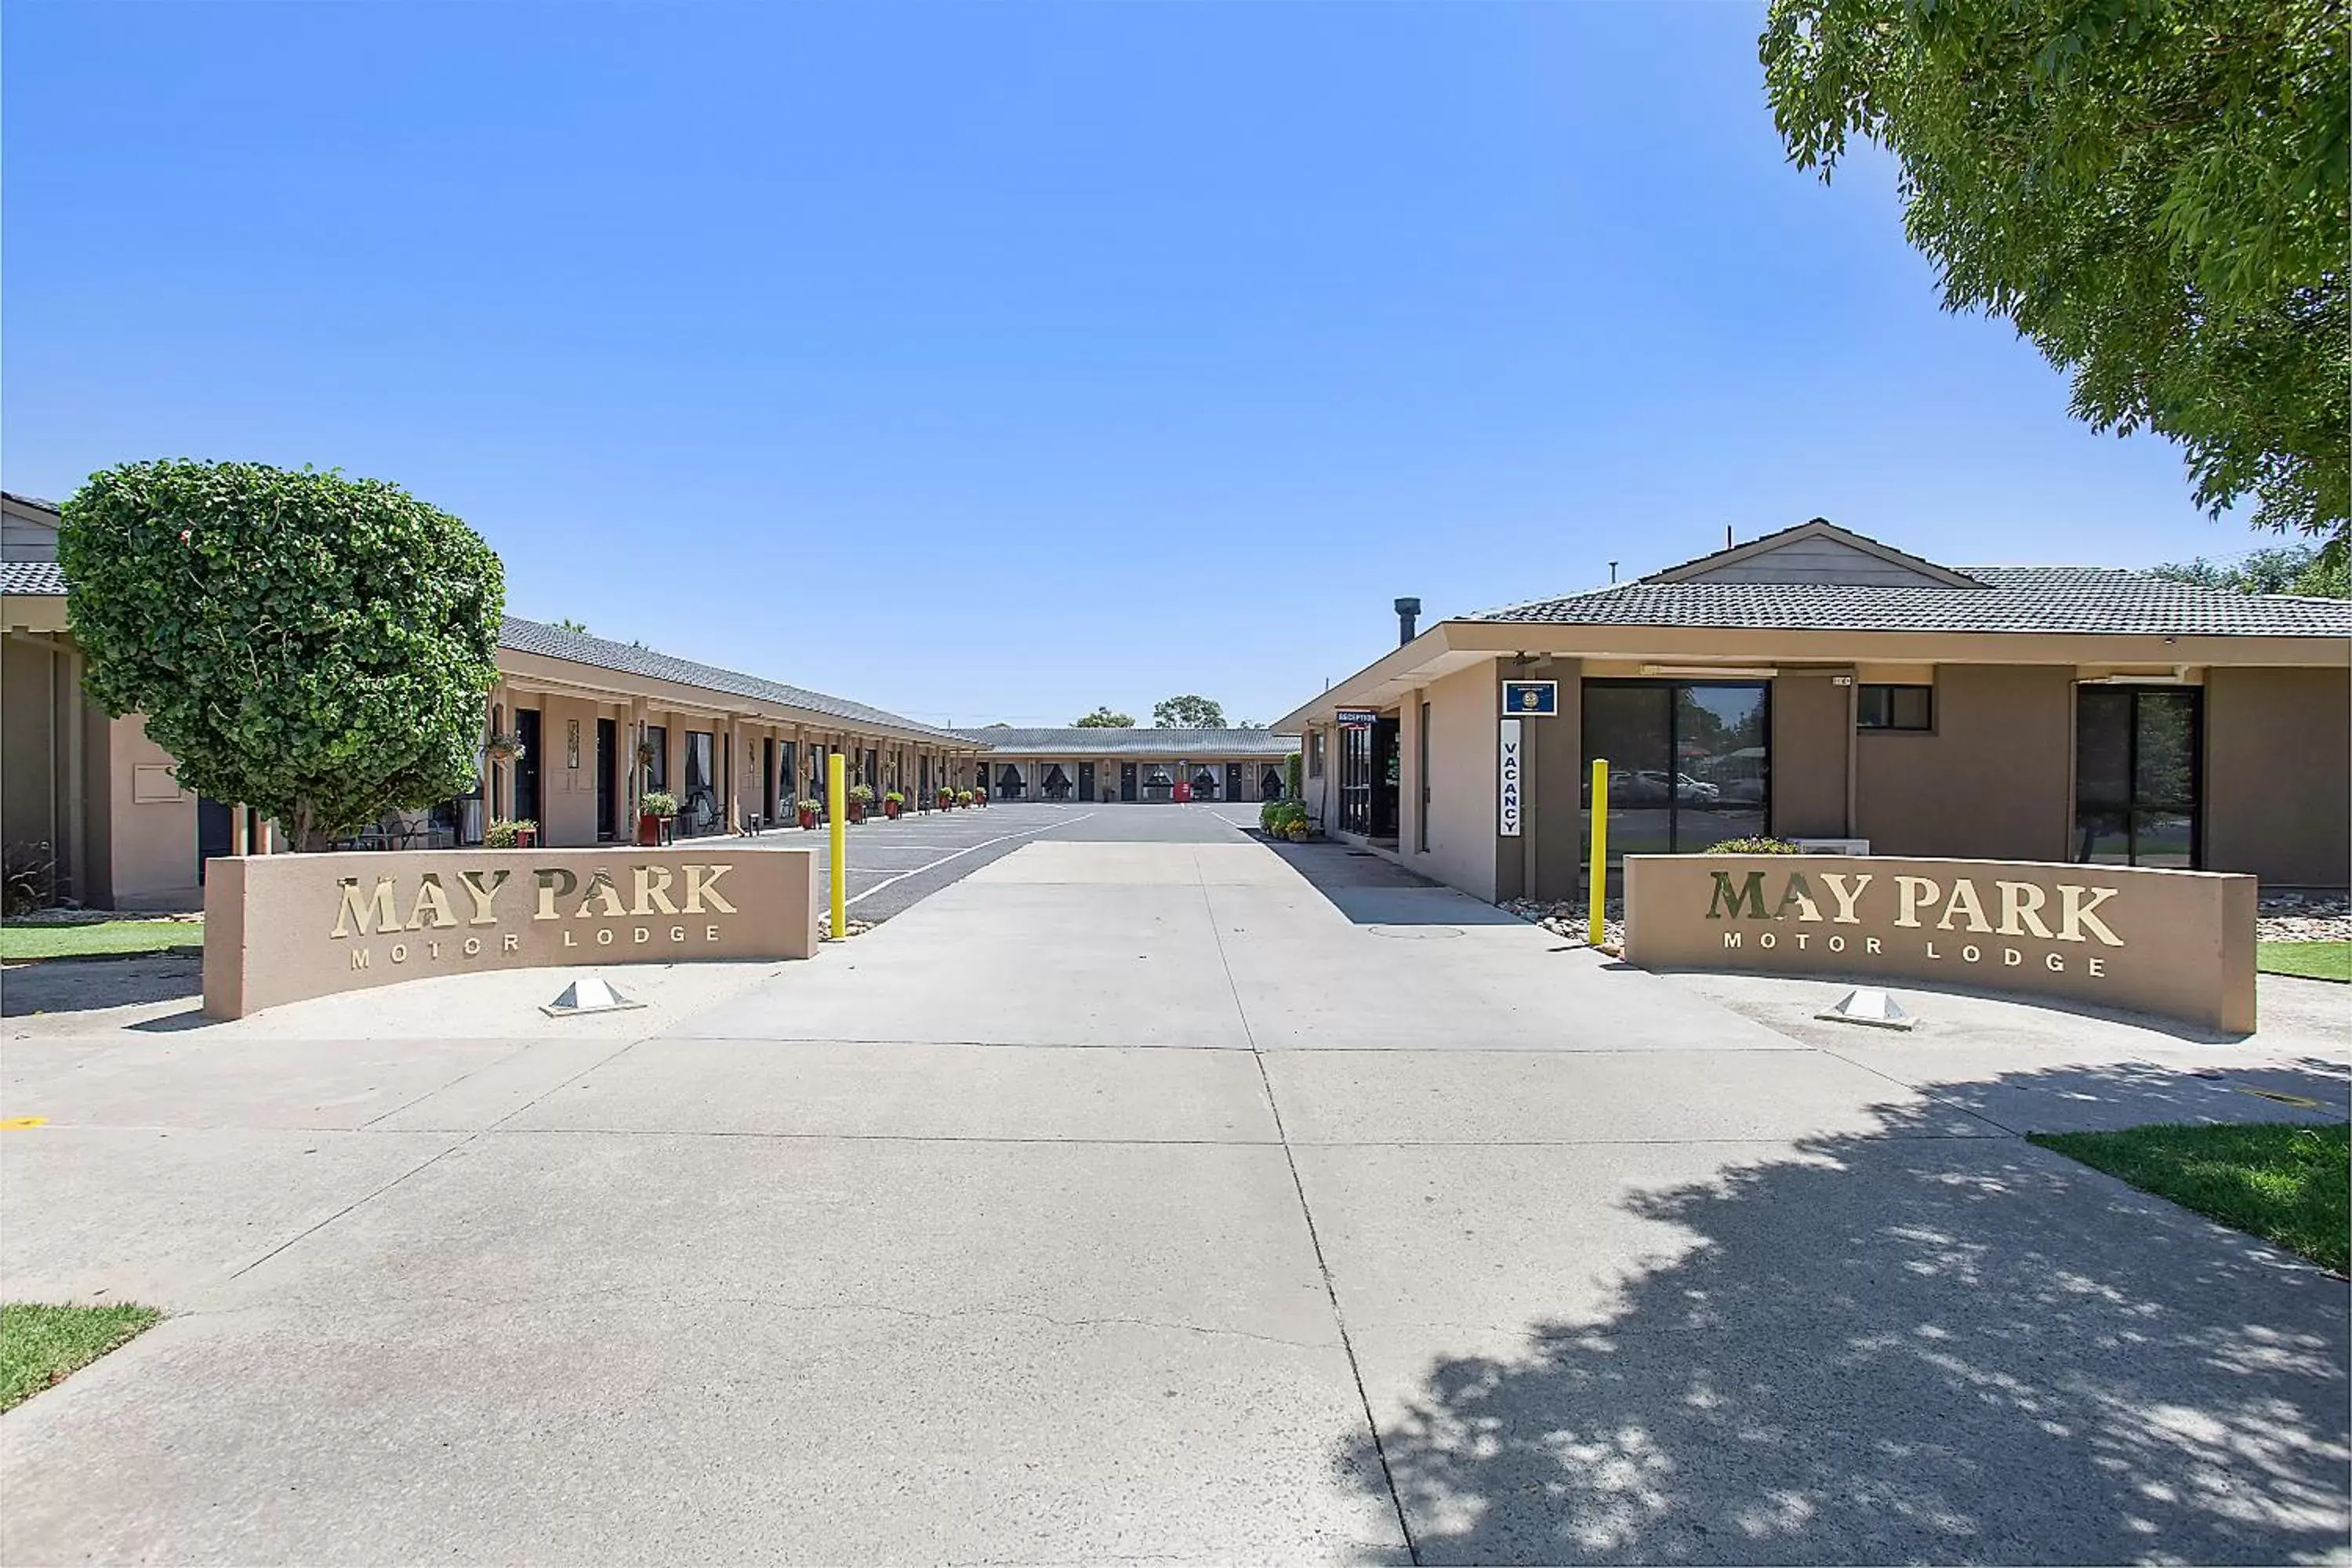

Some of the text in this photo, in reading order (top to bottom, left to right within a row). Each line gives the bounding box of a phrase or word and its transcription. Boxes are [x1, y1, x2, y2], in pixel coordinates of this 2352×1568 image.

[1338, 713, 1376, 721] RECEPTION
[1504, 743, 1517, 832] VACANCY
[329, 864, 738, 938] MAY PARK
[1705, 871, 2125, 946] MAY PARK
[350, 925, 720, 971] MOTOR LODGE
[1724, 932, 2106, 978] MOTOR LODGE
